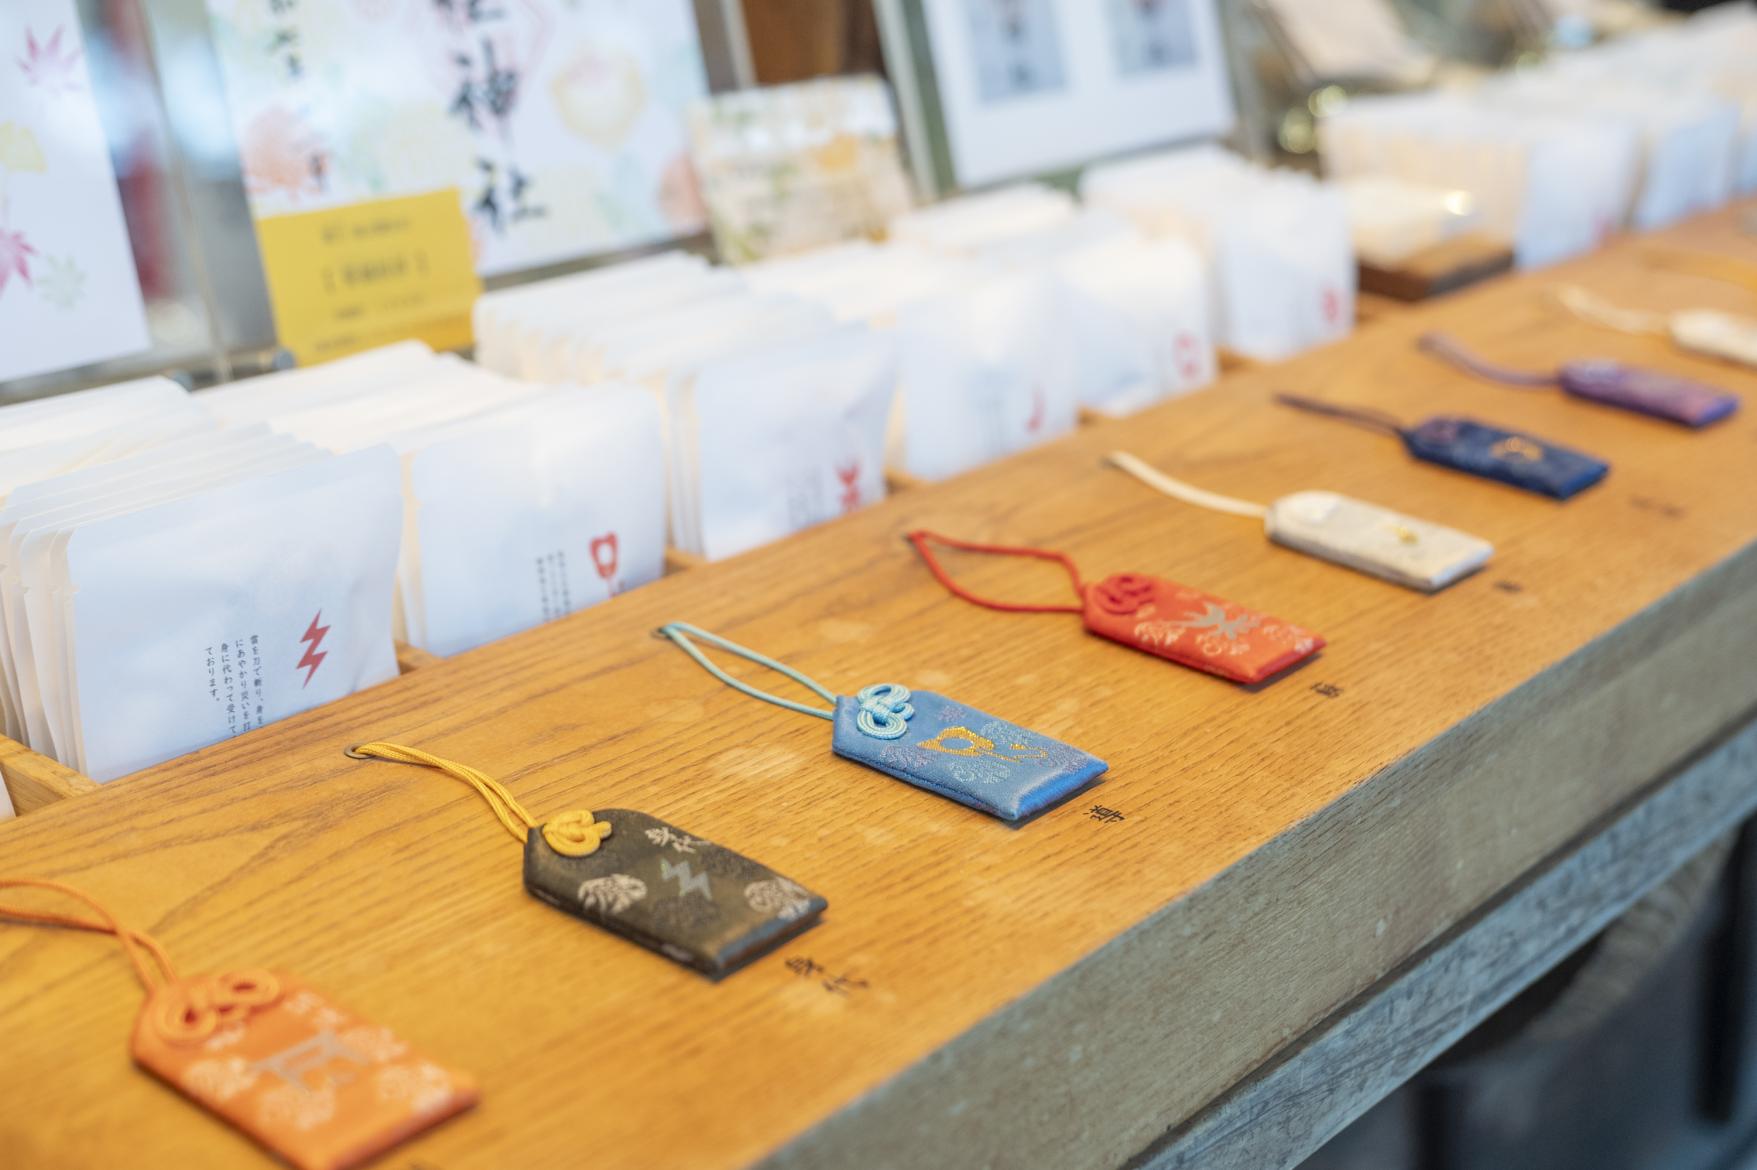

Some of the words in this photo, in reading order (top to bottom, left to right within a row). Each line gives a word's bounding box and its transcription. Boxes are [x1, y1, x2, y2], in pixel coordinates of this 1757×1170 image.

[205, 646, 220, 702] ております。
